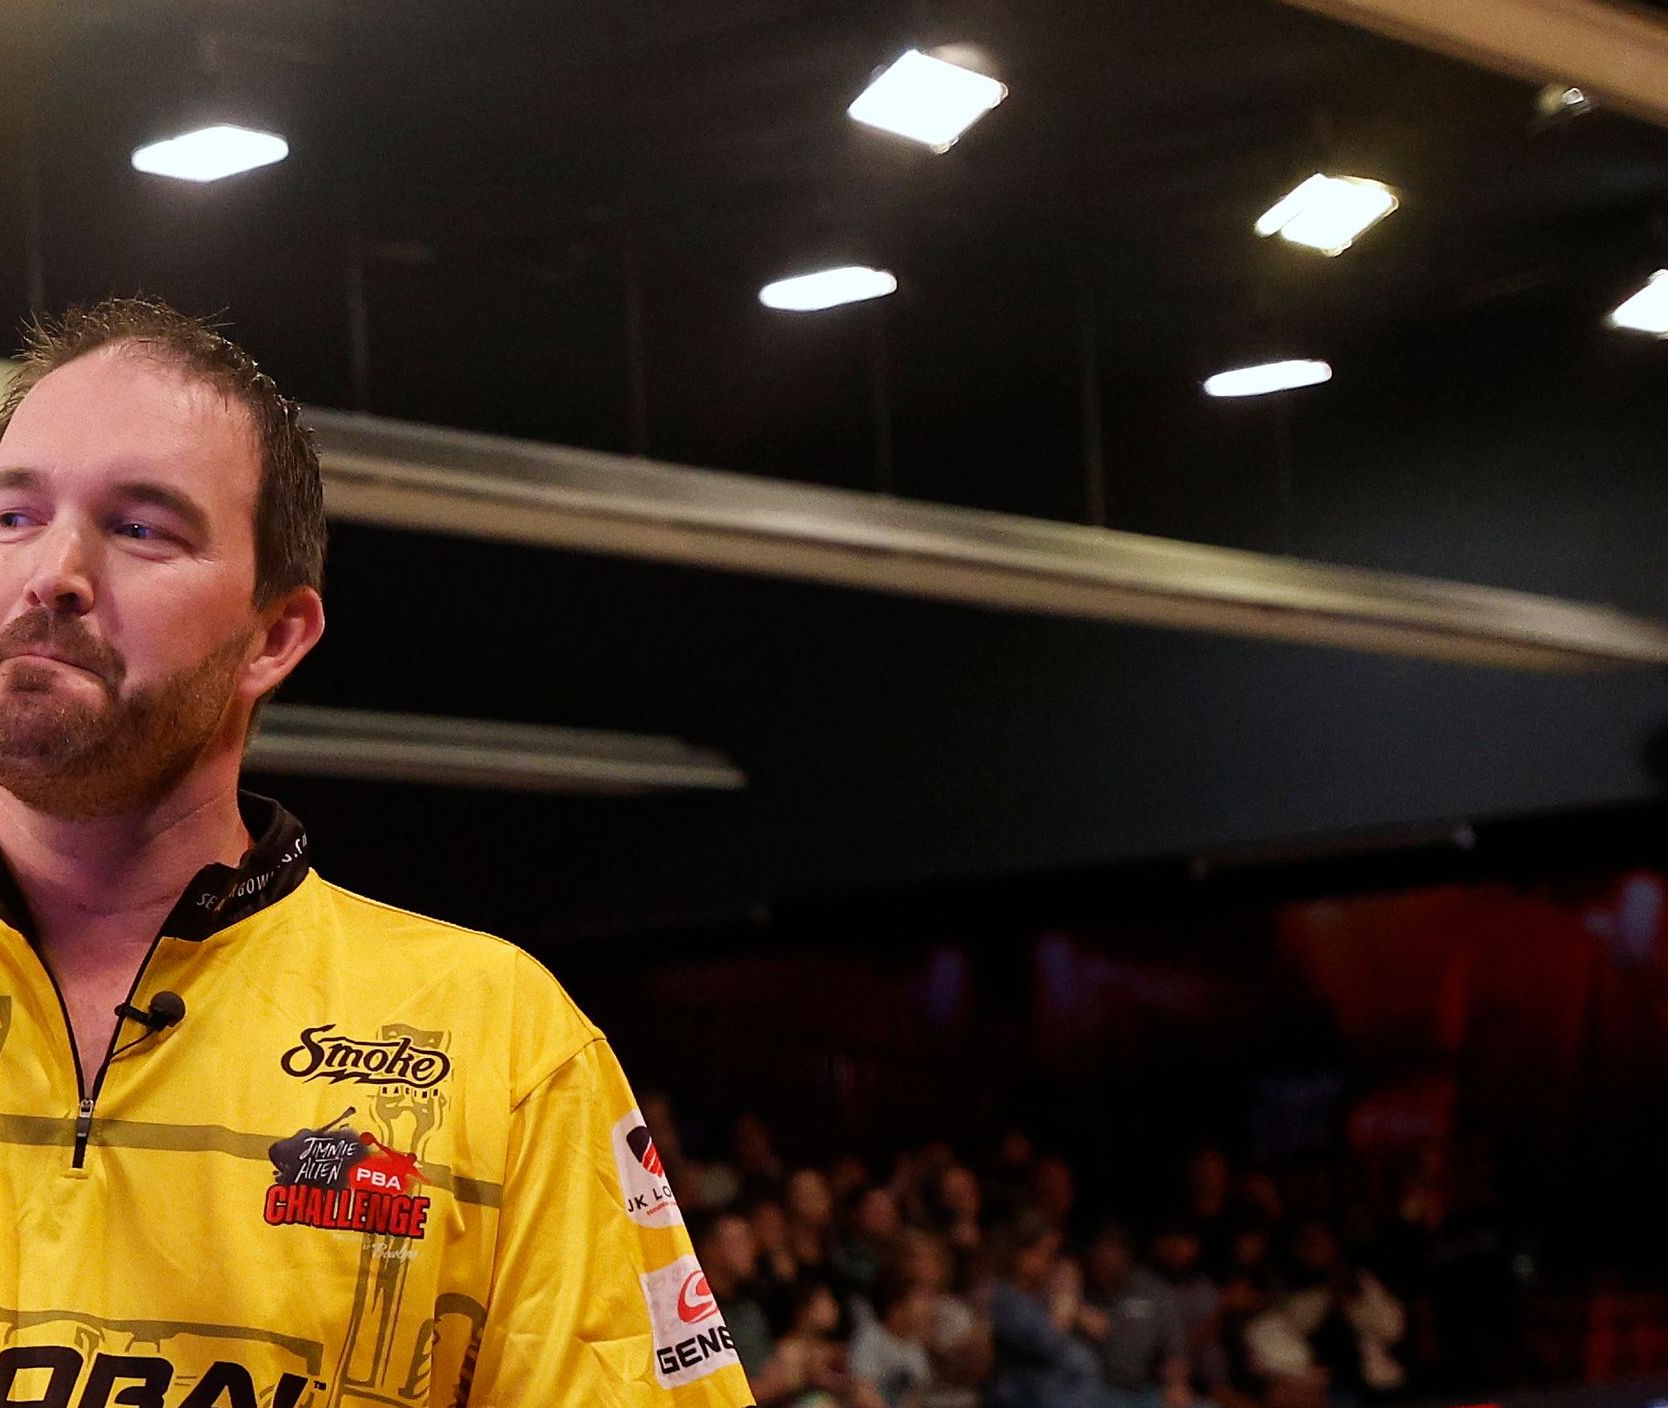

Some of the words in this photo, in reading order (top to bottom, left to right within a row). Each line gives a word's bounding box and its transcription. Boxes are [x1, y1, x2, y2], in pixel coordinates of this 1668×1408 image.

[280, 1023, 451, 1089] Smoke
[300, 1137, 359, 1161] JIMMIE
[356, 1167, 402, 1191] PBA
[264, 1183, 431, 1240] CHALLENGE
[627, 1194, 649, 1213] JK
